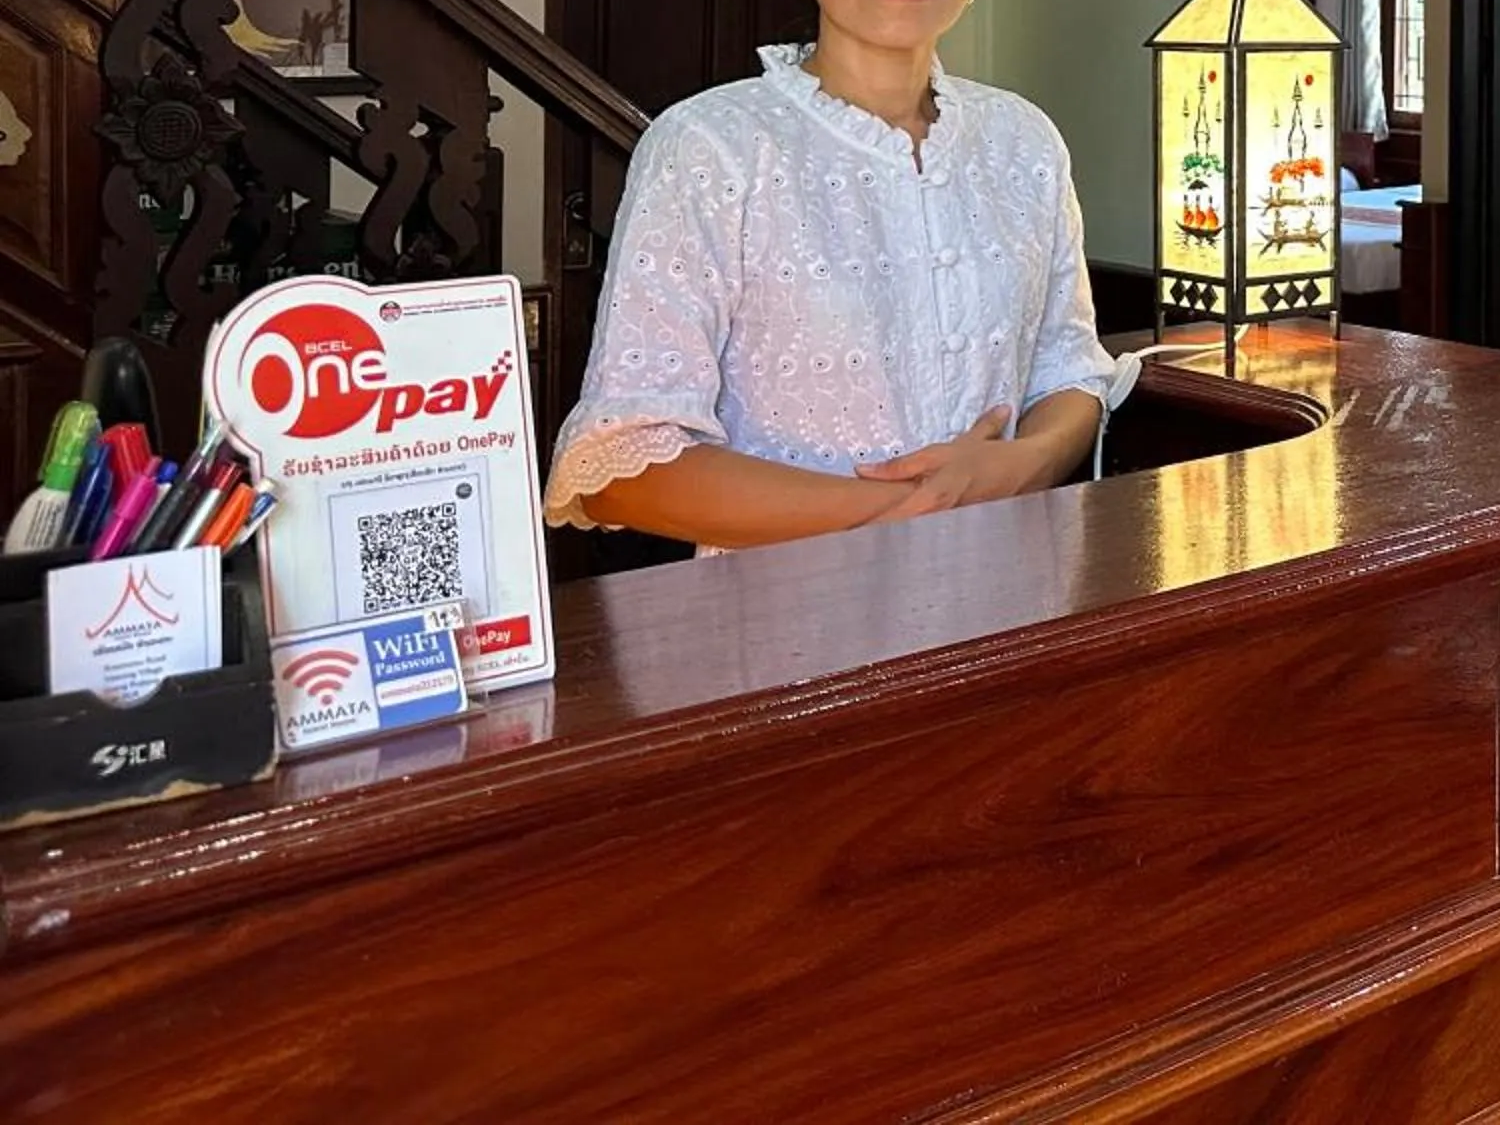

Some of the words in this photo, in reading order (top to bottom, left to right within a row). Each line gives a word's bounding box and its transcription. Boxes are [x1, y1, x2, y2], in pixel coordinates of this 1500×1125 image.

[304, 340, 352, 355] BCEL
[376, 372, 511, 434] pay
[457, 431, 515, 452] OnePay
[373, 632, 440, 660] WiFi
[375, 652, 446, 677] Password
[286, 700, 372, 729] AMMATA
